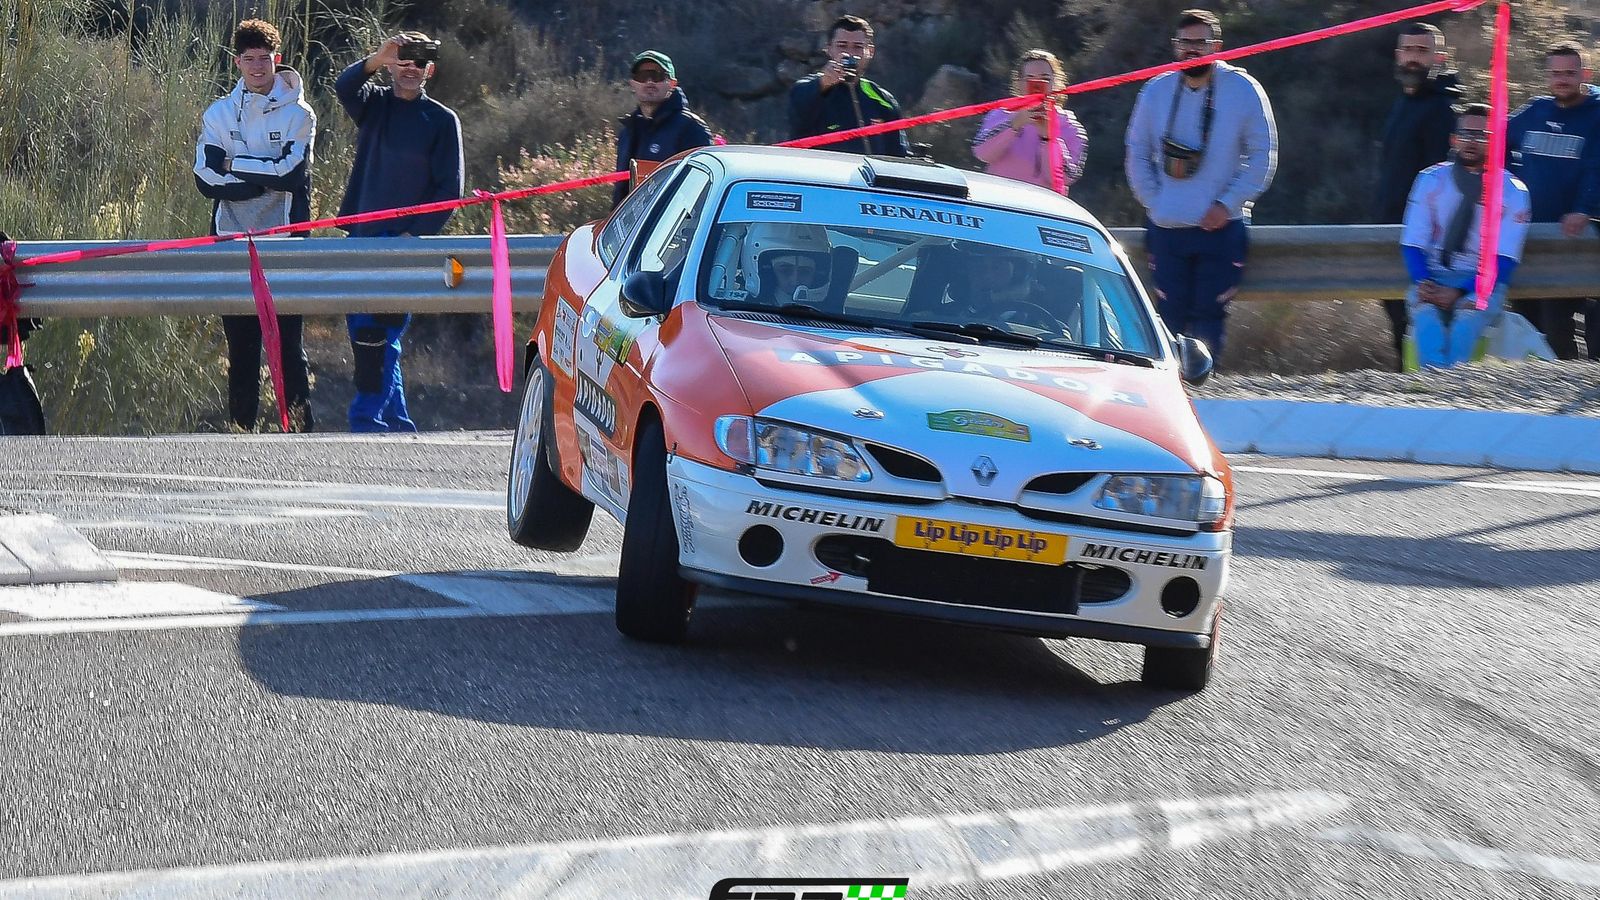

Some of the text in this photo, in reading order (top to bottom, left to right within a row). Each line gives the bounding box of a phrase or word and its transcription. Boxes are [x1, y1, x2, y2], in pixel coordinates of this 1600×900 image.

[860, 203, 984, 228] RENAULT
[789, 351, 1136, 404] APIGADOR
[576, 376, 616, 433] APIGADOR
[746, 500, 885, 532] MICHELIN
[915, 521, 1048, 554] Lip Lip Lip Lip
[1081, 543, 1208, 570] MICHELIN
